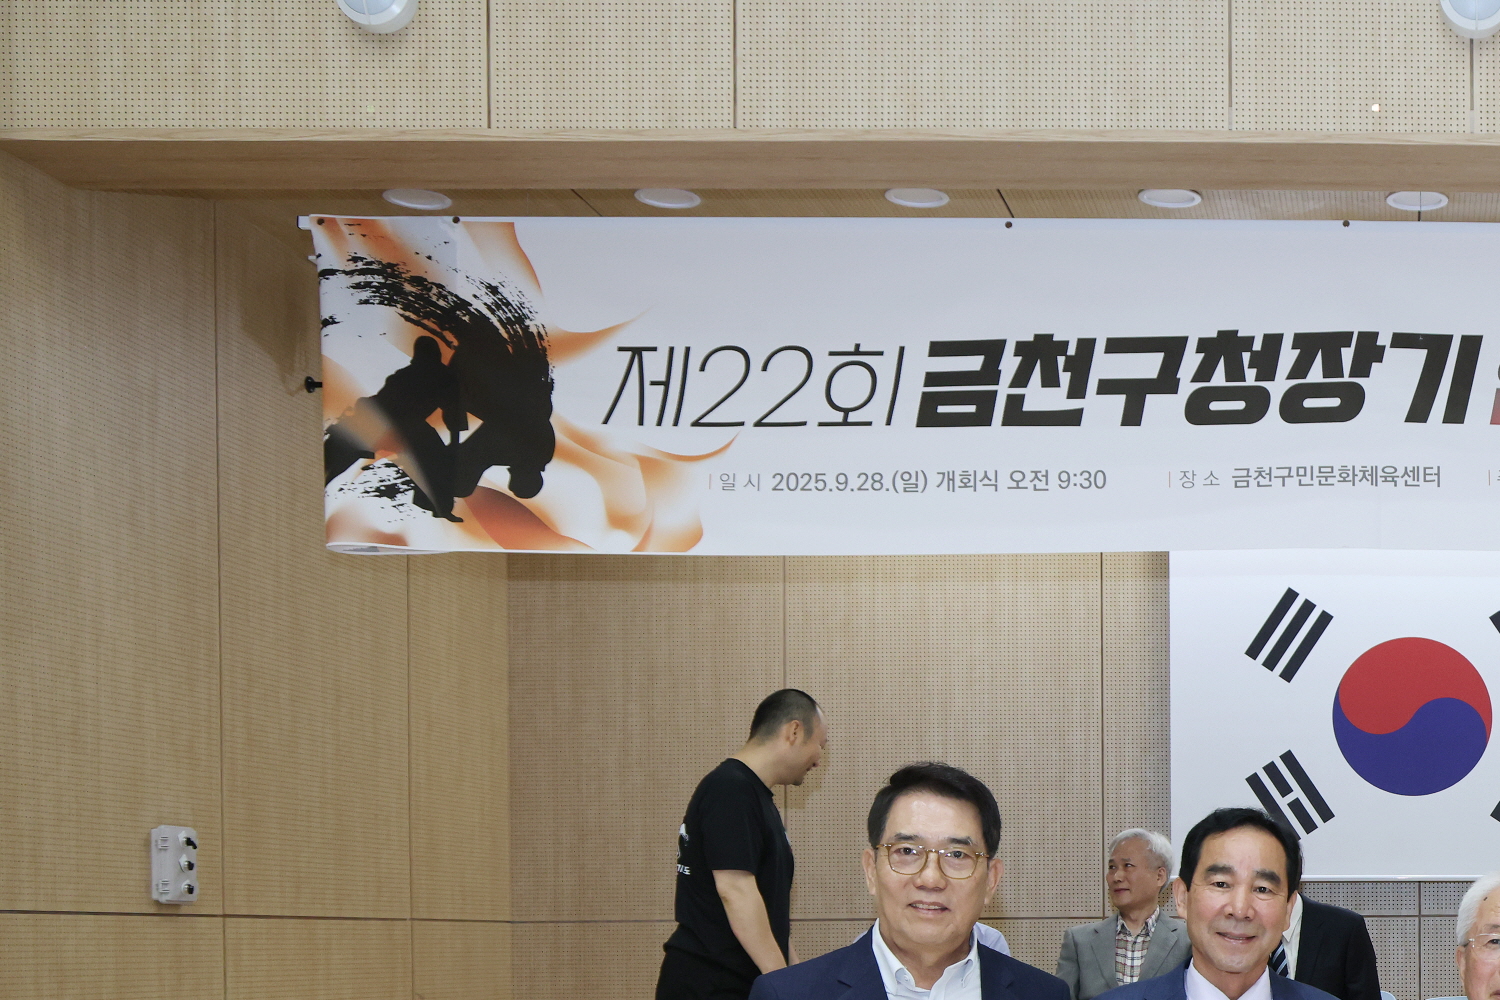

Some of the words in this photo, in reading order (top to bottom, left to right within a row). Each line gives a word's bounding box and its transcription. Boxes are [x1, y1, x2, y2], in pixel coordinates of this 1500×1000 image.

[601, 343, 906, 427] 제22회
[915, 329, 1484, 428] 금천구청장기
[771, 469, 928, 494] 2025.9.28.(일)
[935, 469, 999, 493] 개회식
[1006, 469, 1050, 492] 오전
[1057, 469, 1107, 490] 9:30
[1231, 464, 1441, 489] 금천구민문화체육센터
